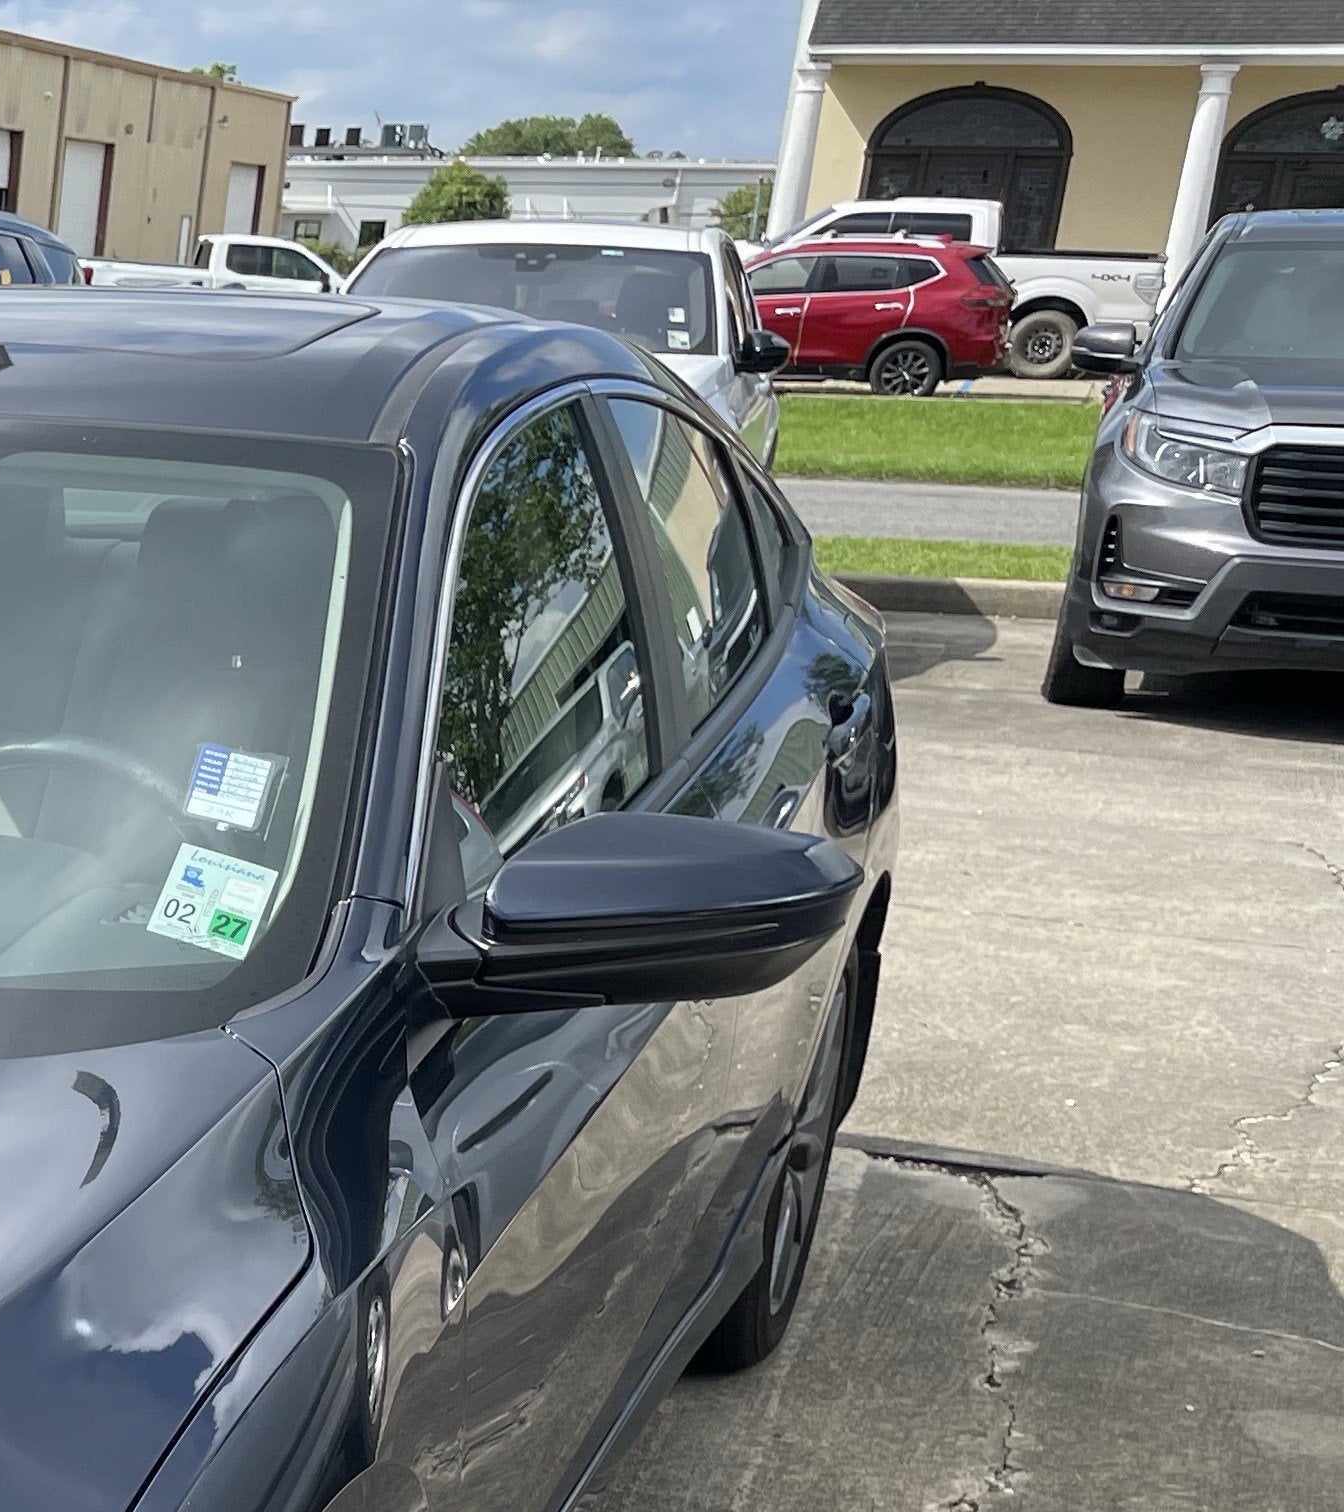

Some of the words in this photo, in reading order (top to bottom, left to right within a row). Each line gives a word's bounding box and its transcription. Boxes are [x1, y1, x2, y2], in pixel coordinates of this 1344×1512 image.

[190, 849, 266, 882] Louisiana
[164, 898, 196, 925] 02
[212, 913, 248, 940] 27
